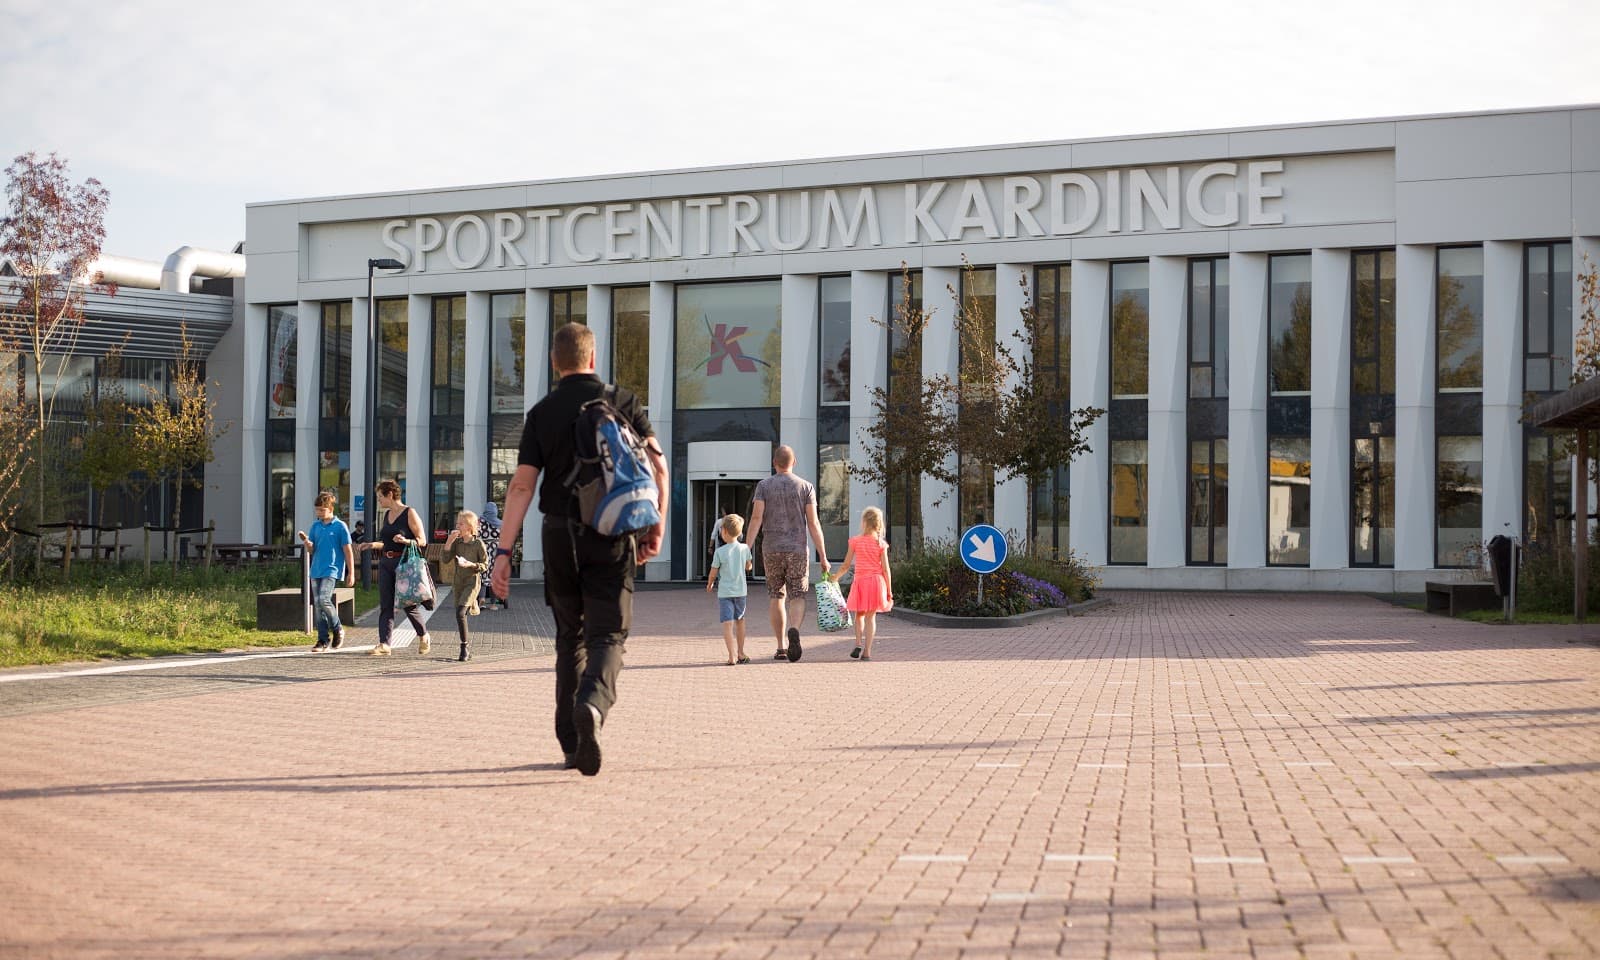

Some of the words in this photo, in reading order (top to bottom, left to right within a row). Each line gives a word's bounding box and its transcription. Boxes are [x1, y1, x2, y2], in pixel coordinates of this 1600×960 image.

[382, 187, 882, 274] SPORTCENTRUM
[904, 160, 1284, 244] KARDINGE
[706, 323, 758, 376] K
